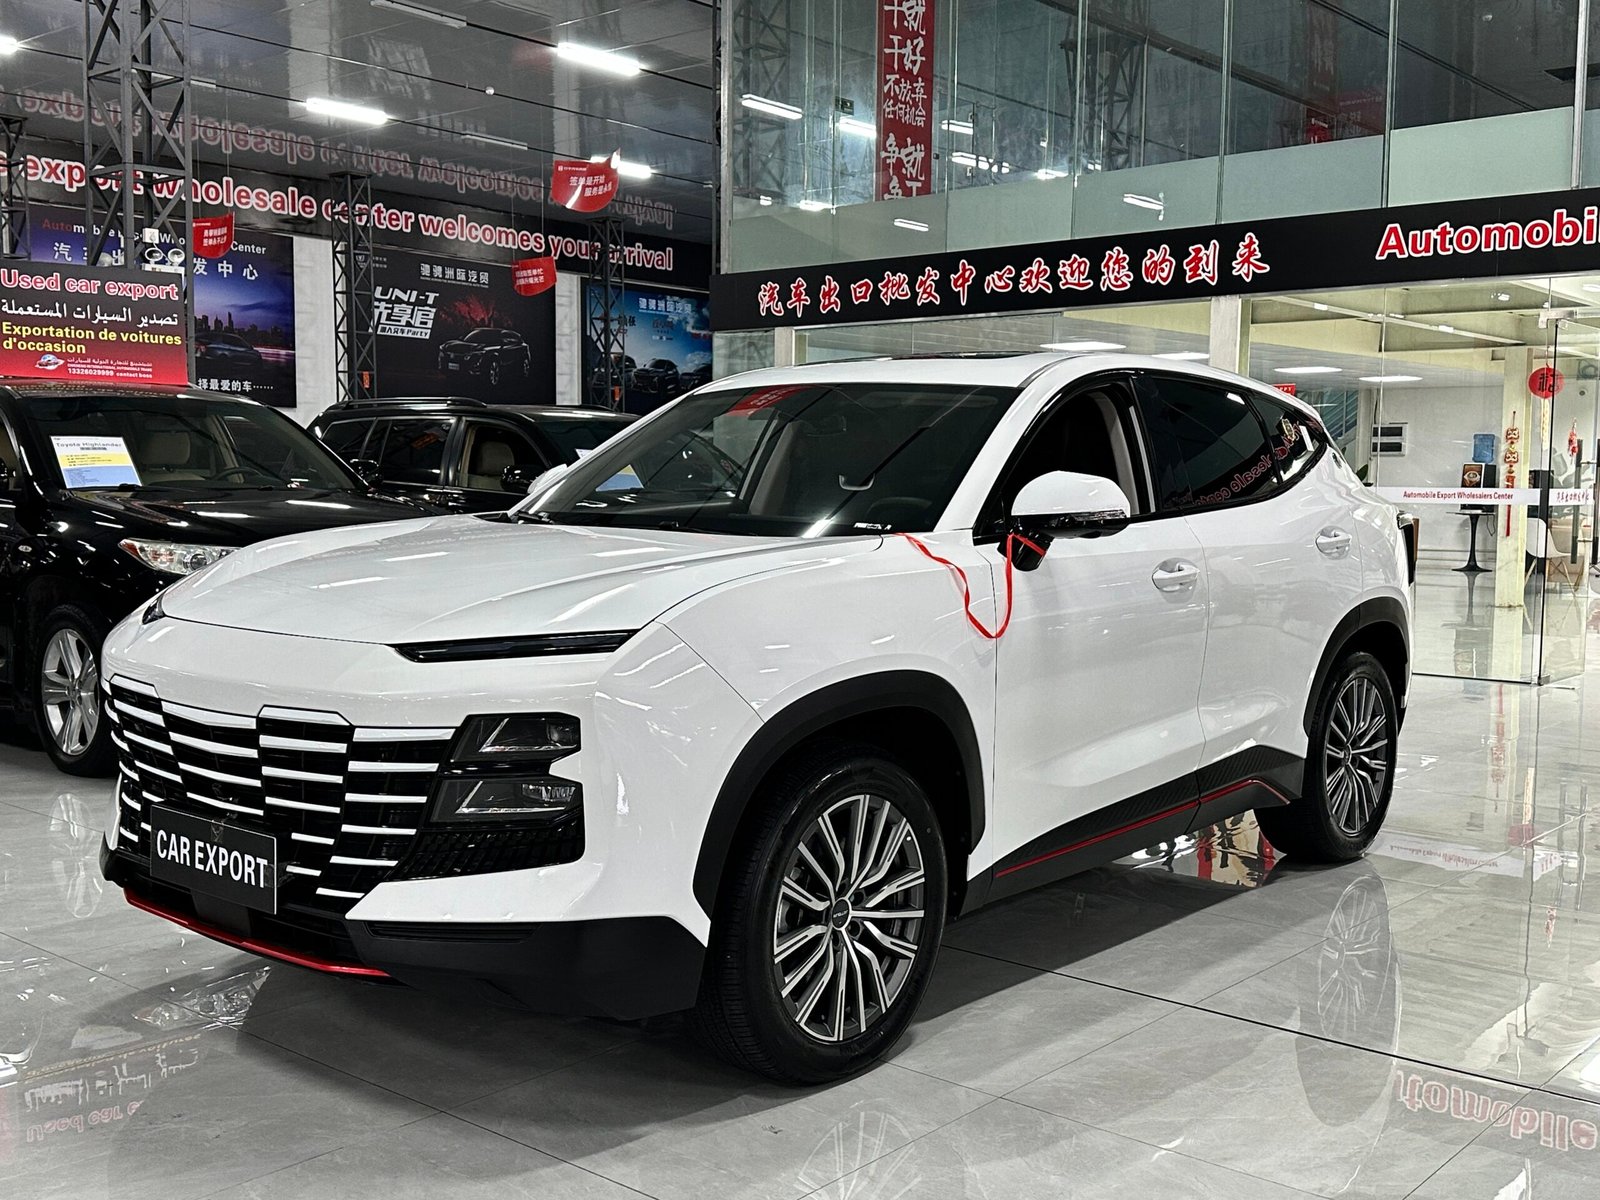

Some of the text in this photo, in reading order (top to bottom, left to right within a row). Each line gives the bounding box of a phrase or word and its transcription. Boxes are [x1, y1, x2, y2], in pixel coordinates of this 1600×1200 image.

[884, 74, 927, 105] 不放弃
[883, 99, 926, 127] 任何机会
[322, 198, 414, 232] center
[419, 212, 545, 252] welcomes
[548, 234, 602, 259] your
[607, 243, 674, 271] arrival
[1375, 206, 1600, 260] Automobi
[231, 241, 267, 255] Center
[0, 268, 179, 300] Used car export
[374, 286, 439, 304] UNI-T
[1, 299, 179, 328] تصدير السيارات المستعملة
[2, 321, 182, 345] Exportation de voitures
[2, 337, 86, 354] d'occasion
[1403, 490, 1436, 499] Automobile
[1437, 491, 1456, 500] Export
[1493, 492, 1513, 500] Center
[156, 829, 269, 888] CAR EXPORT
